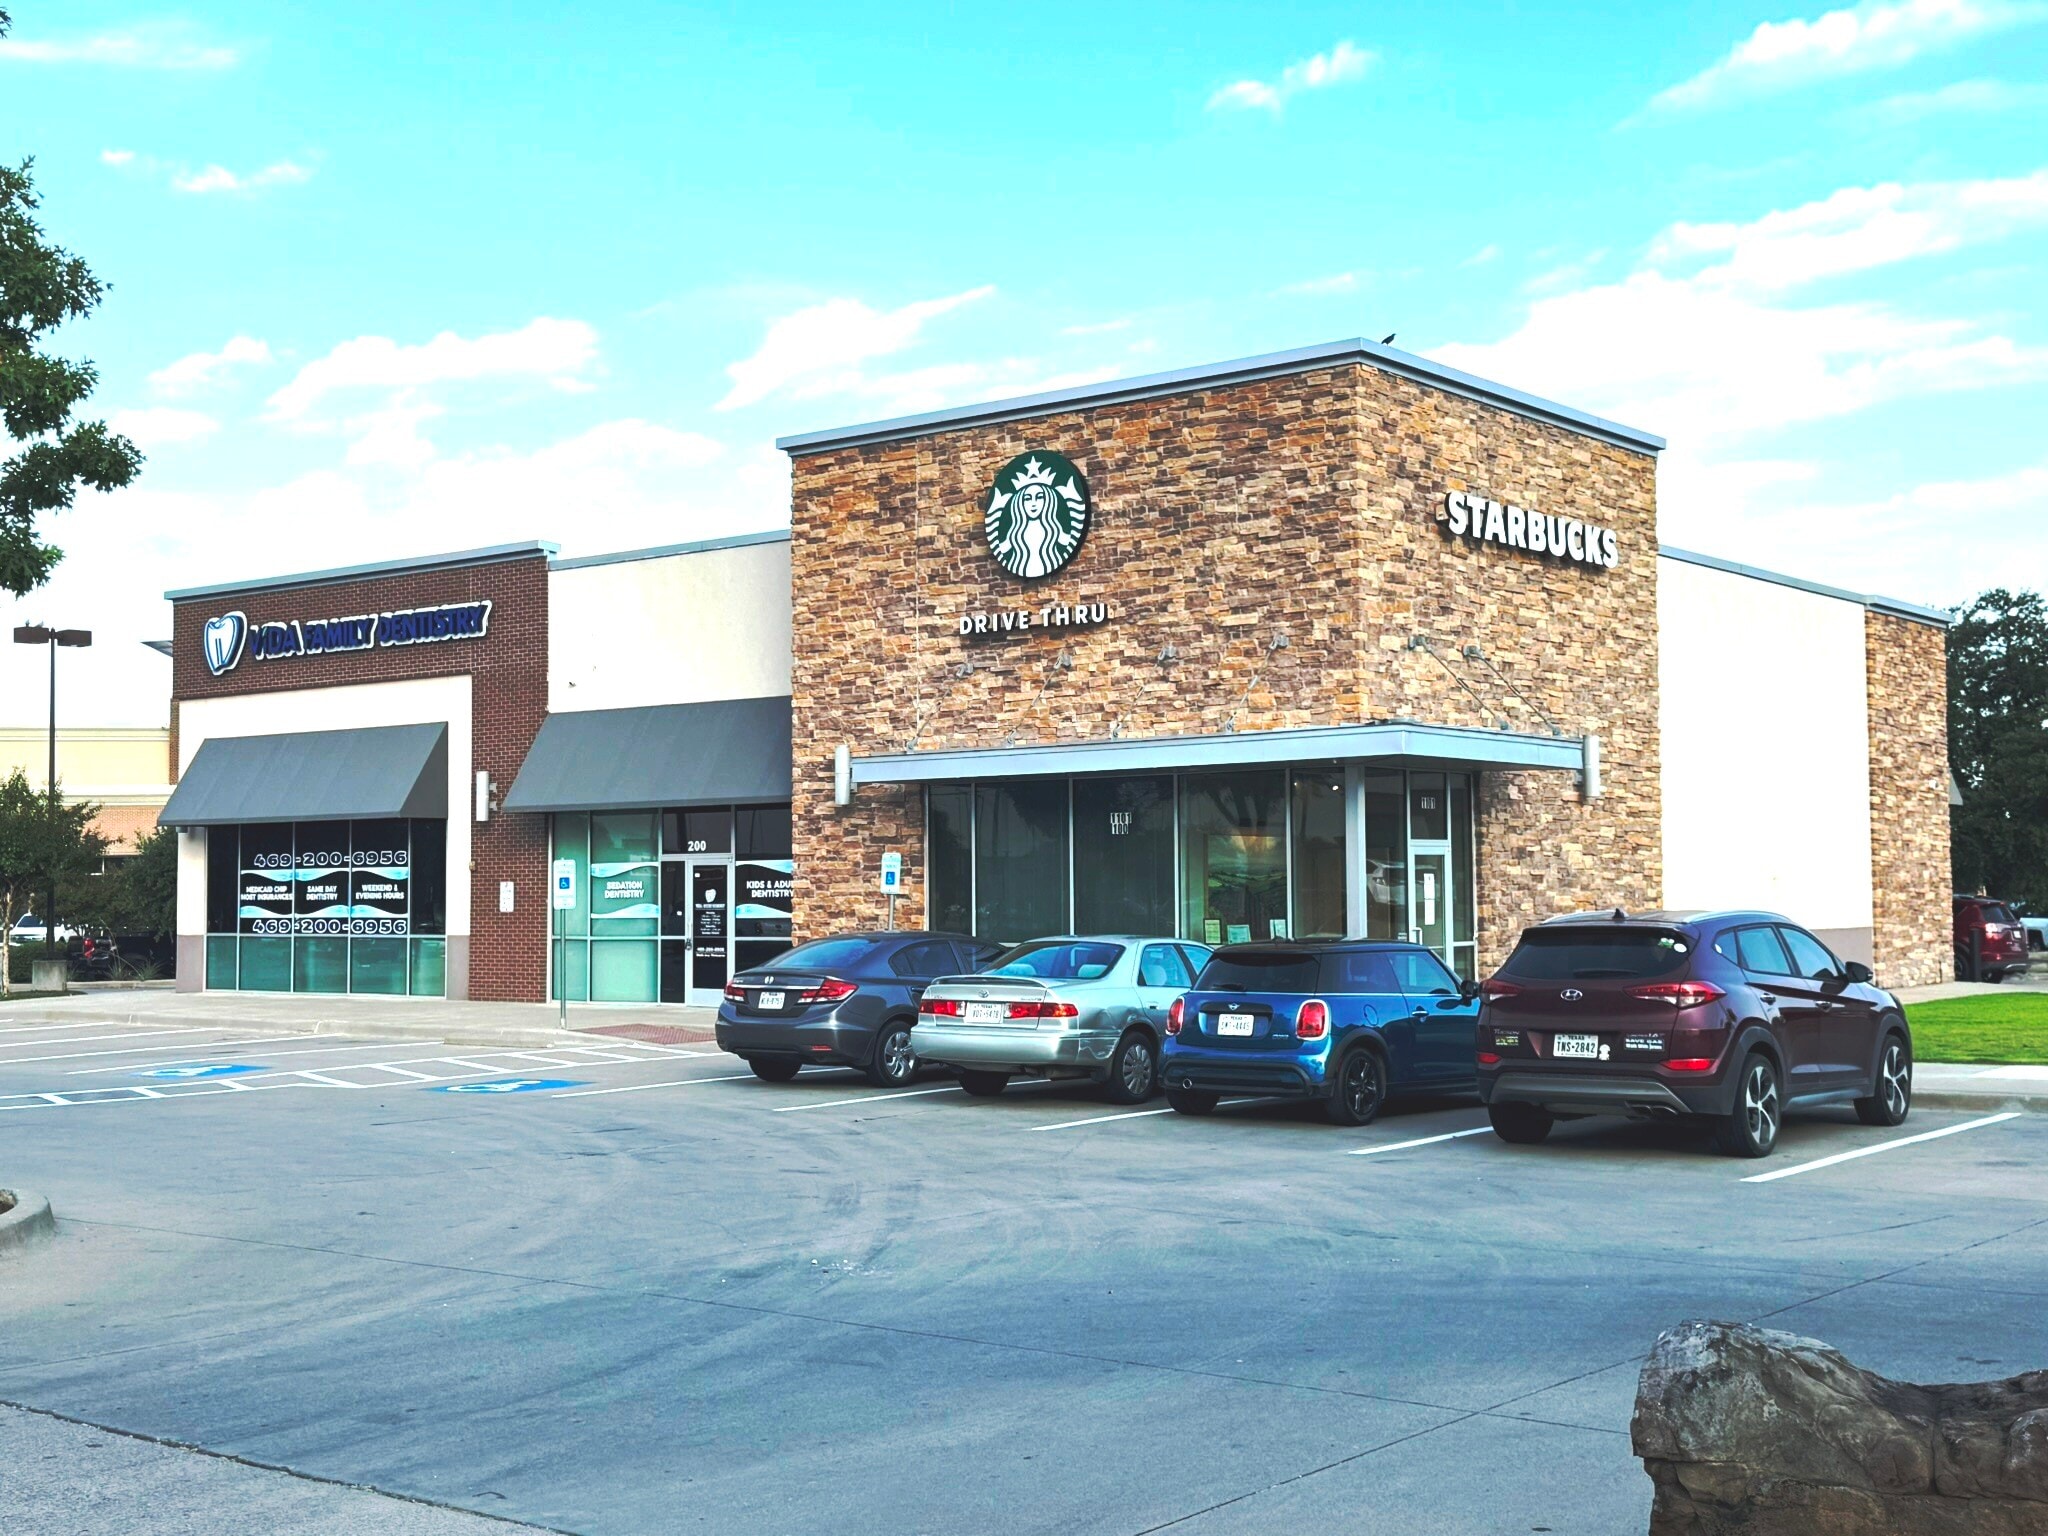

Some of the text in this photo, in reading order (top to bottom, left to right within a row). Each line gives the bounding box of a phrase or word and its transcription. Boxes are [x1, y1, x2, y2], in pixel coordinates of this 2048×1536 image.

[1447, 491, 1619, 569] STARBUCKS
[959, 602, 1106, 634] DRIVE THRU
[249, 602, 489, 658] VIDA FAMILY DENTISTRY
[687, 840, 707, 851] 200
[307, 885, 338, 893] SAME DAY
[362, 884, 393, 892] WEEKEND
[606, 881, 643, 890] SEDATION
[746, 880, 791, 889] KIDS & ADU
[604, 889, 645, 899] DENTISTRY
[751, 889, 794, 898] DENTISTRY
